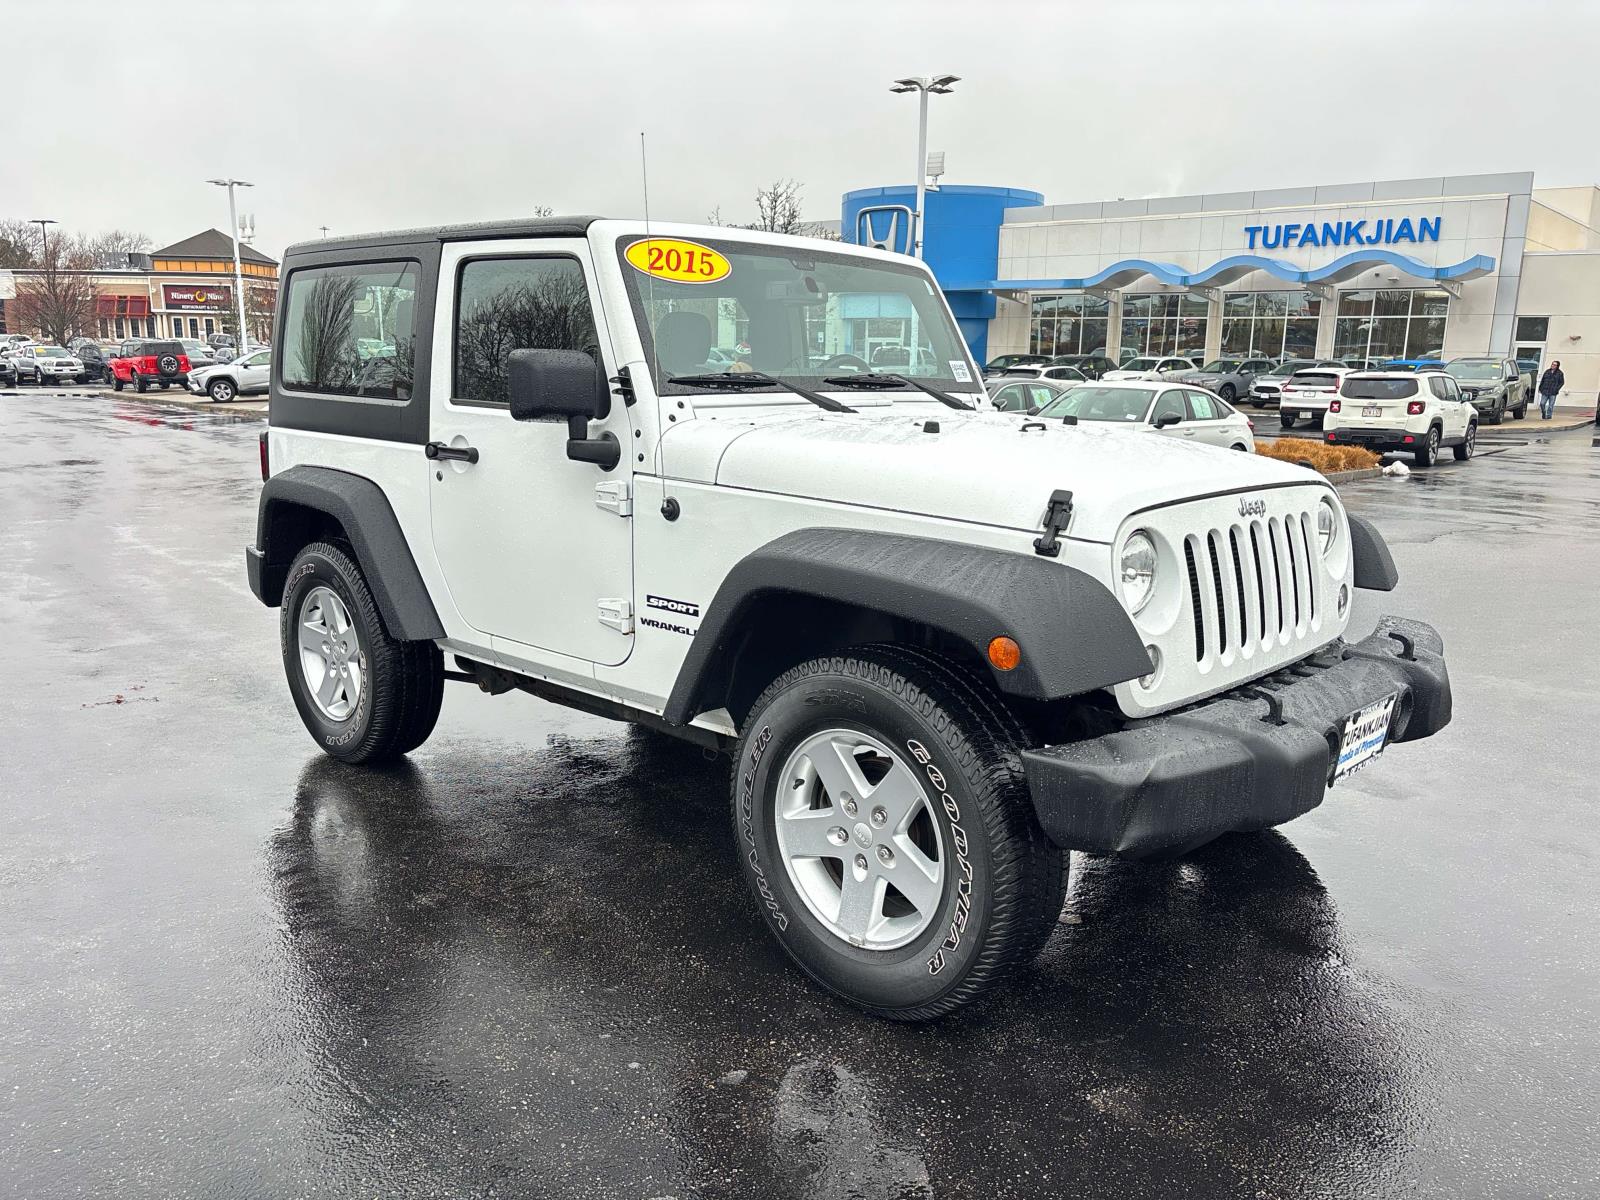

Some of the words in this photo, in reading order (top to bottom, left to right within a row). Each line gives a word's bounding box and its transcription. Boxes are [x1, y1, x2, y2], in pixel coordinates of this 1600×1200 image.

[1244, 217, 1441, 249] TUFANKJIAN
[648, 247, 714, 276] 2015
[171, 292, 195, 301] Ninety
[1238, 497, 1266, 517] Jeep
[648, 597, 697, 614] SPORT
[1341, 710, 1391, 749] TUFANKJIAN
[742, 725, 788, 932] WRANGLER
[907, 740, 973, 976] GOODYEAR
